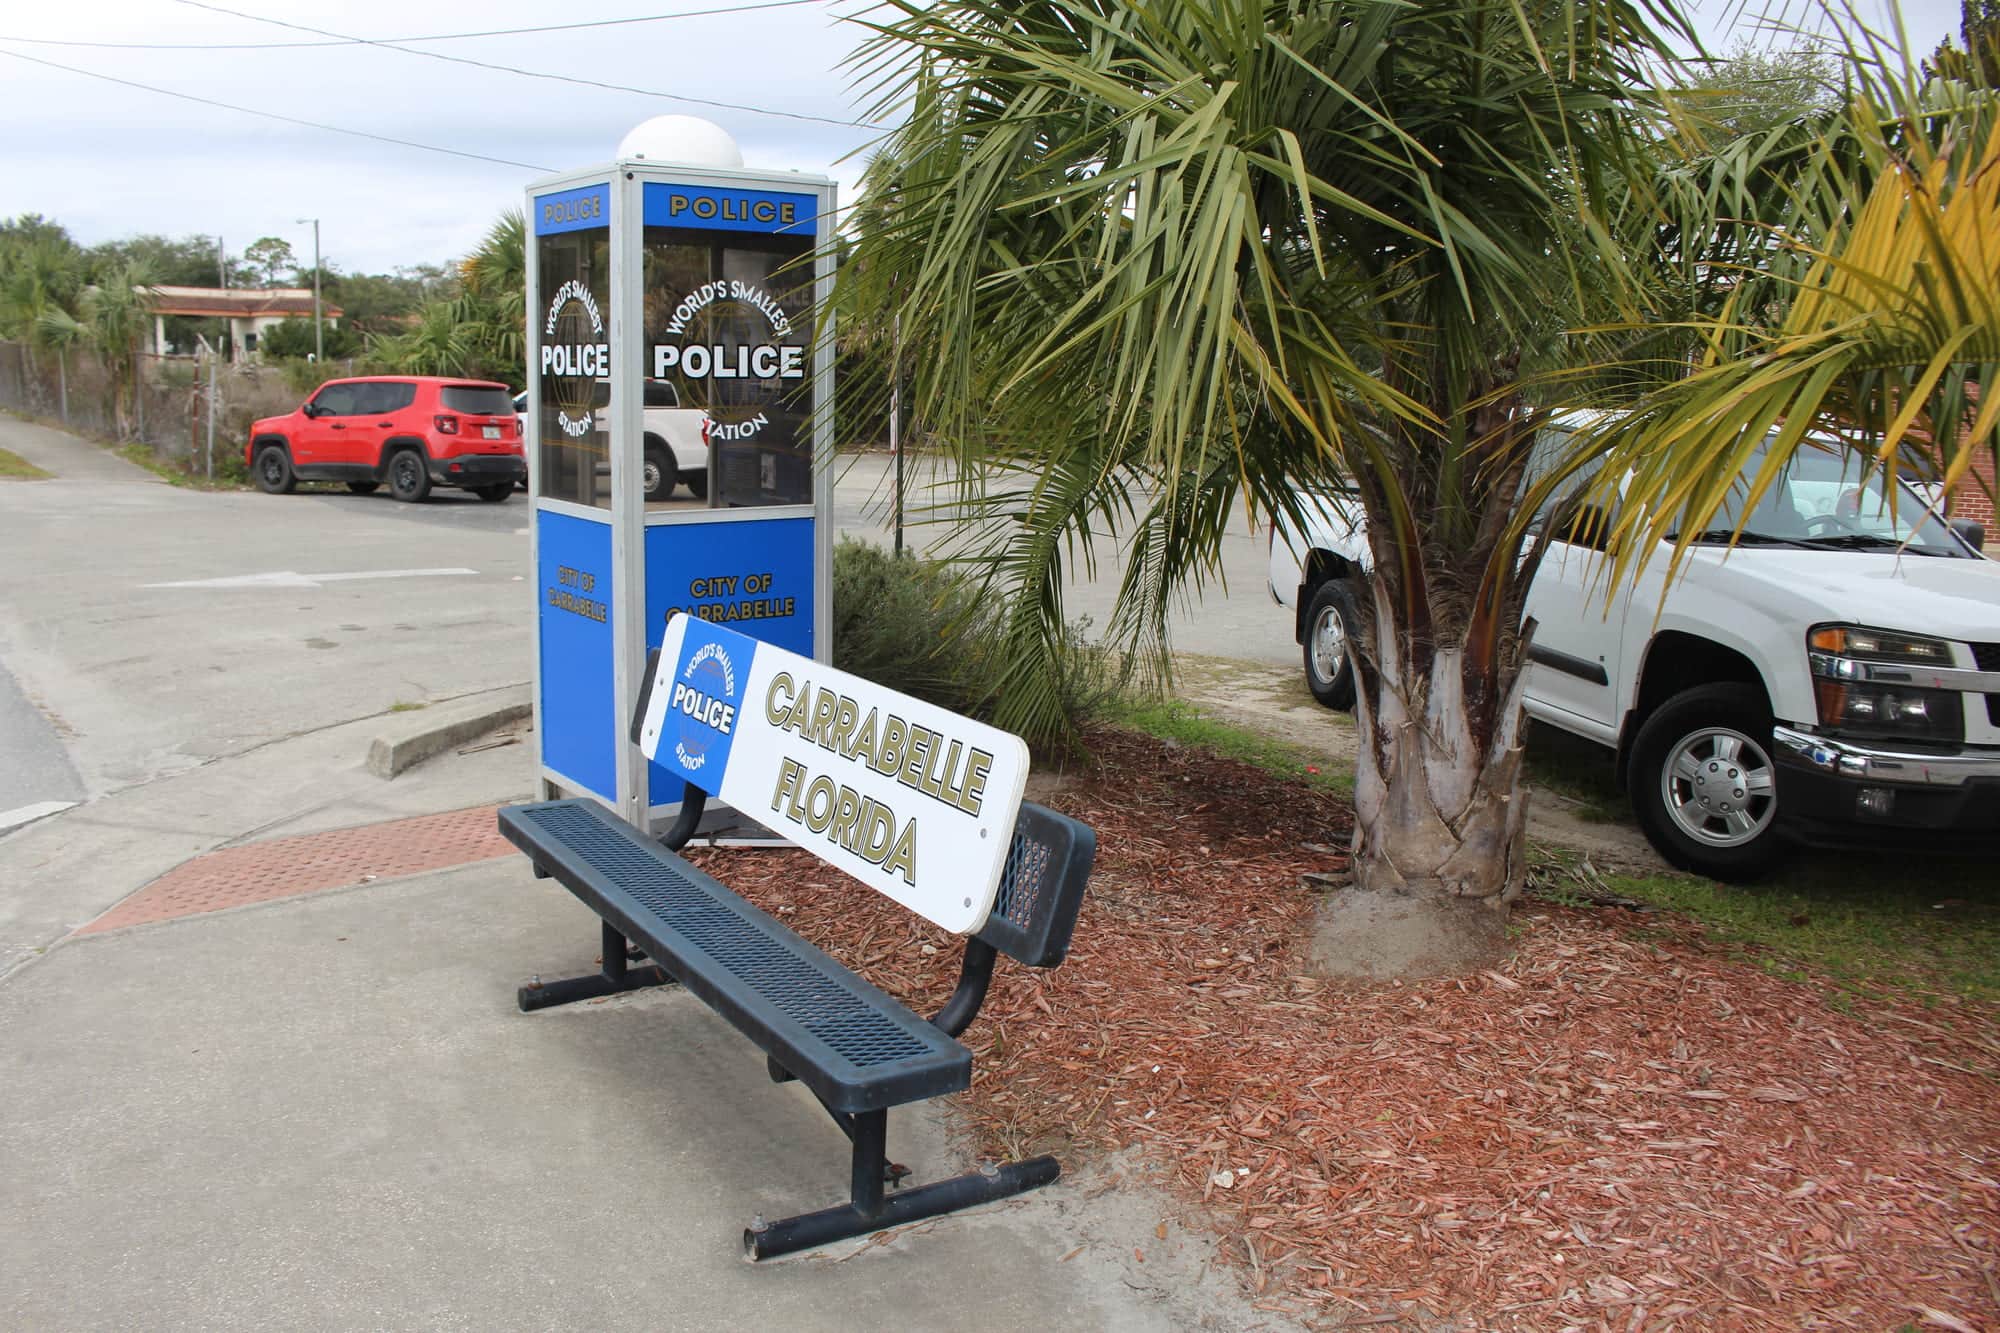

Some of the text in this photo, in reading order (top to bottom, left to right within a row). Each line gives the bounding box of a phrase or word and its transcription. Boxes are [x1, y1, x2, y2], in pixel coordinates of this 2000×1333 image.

[544, 196, 601, 225] POLICE
[669, 194, 796, 224] POLICE
[546, 280, 603, 335] WORLD'S SMALLEST
[666, 280, 793, 337] WORLD'S SMALLEST
[541, 343, 609, 377] POLICE
[652, 344, 805, 379] POLICE
[558, 410, 593, 437] STATION
[557, 565, 596, 593] CITY OF
[690, 573, 773, 598] CITY OF
[548, 587, 608, 623] CARRABELLE
[684, 643, 735, 697] WORLD'S SMALLEST
[671, 681, 736, 735] POLICE
[675, 742, 706, 771] STATION
[765, 671, 994, 818] CARRABELLE
[771, 756, 917, 887] FLORIDA
